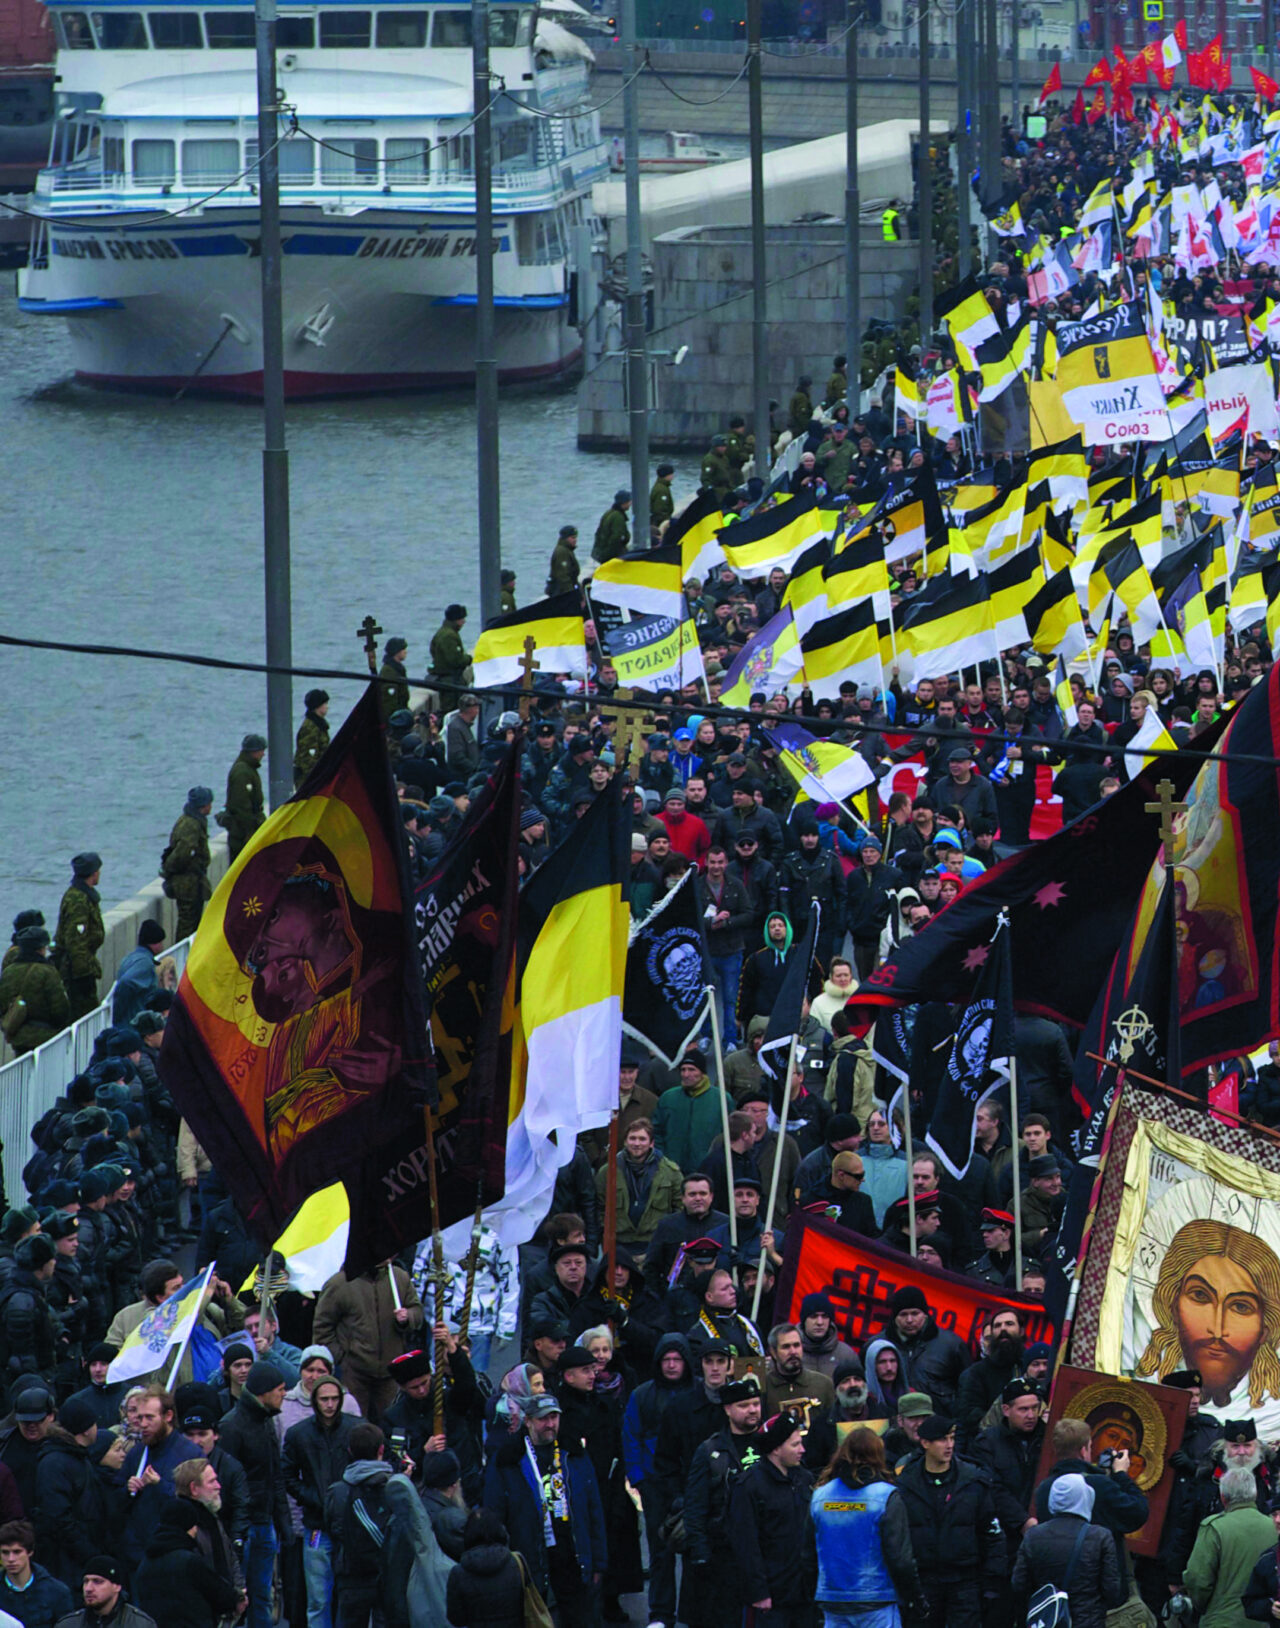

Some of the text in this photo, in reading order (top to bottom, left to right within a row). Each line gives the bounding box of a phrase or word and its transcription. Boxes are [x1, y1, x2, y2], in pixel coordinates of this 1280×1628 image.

[358, 233, 449, 258] ВАЛЕРИЙ
[1206, 391, 1248, 413] ный
[1104, 422, 1150, 439] Союз
